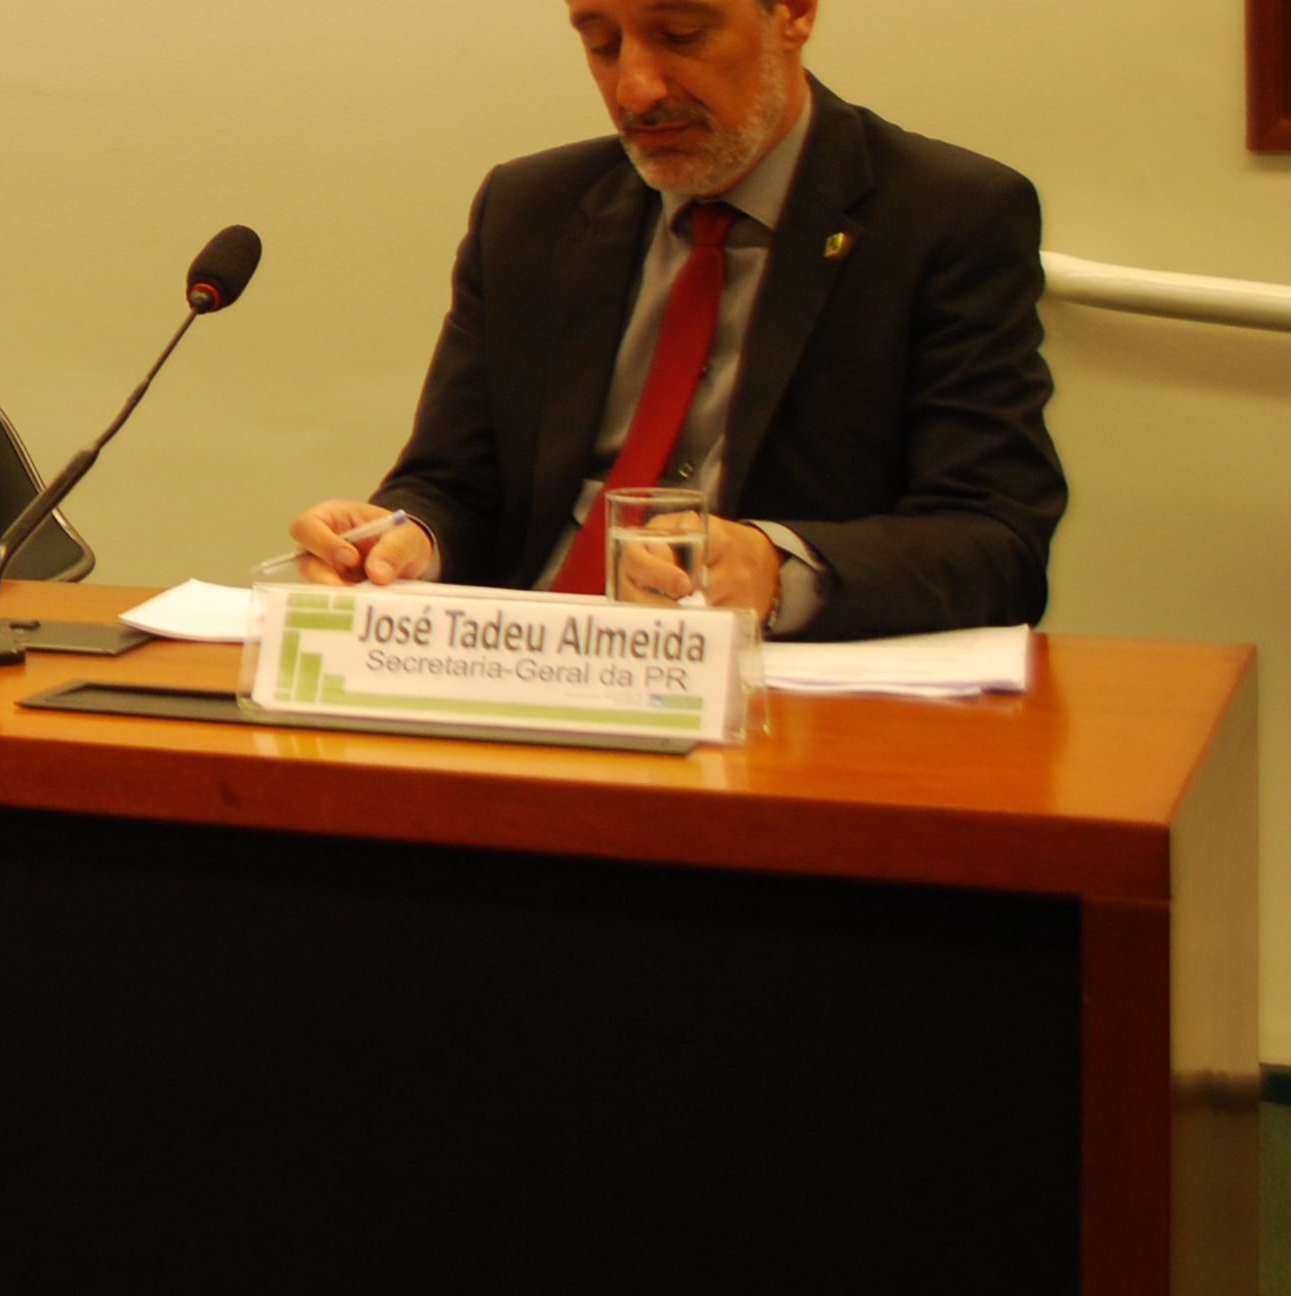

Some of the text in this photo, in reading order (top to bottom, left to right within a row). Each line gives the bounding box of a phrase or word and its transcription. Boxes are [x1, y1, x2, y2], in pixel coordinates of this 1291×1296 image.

[358, 604, 707, 663] José Tadeu Almeida
[365, 650, 689, 691] Secretaria-Geral da PR
